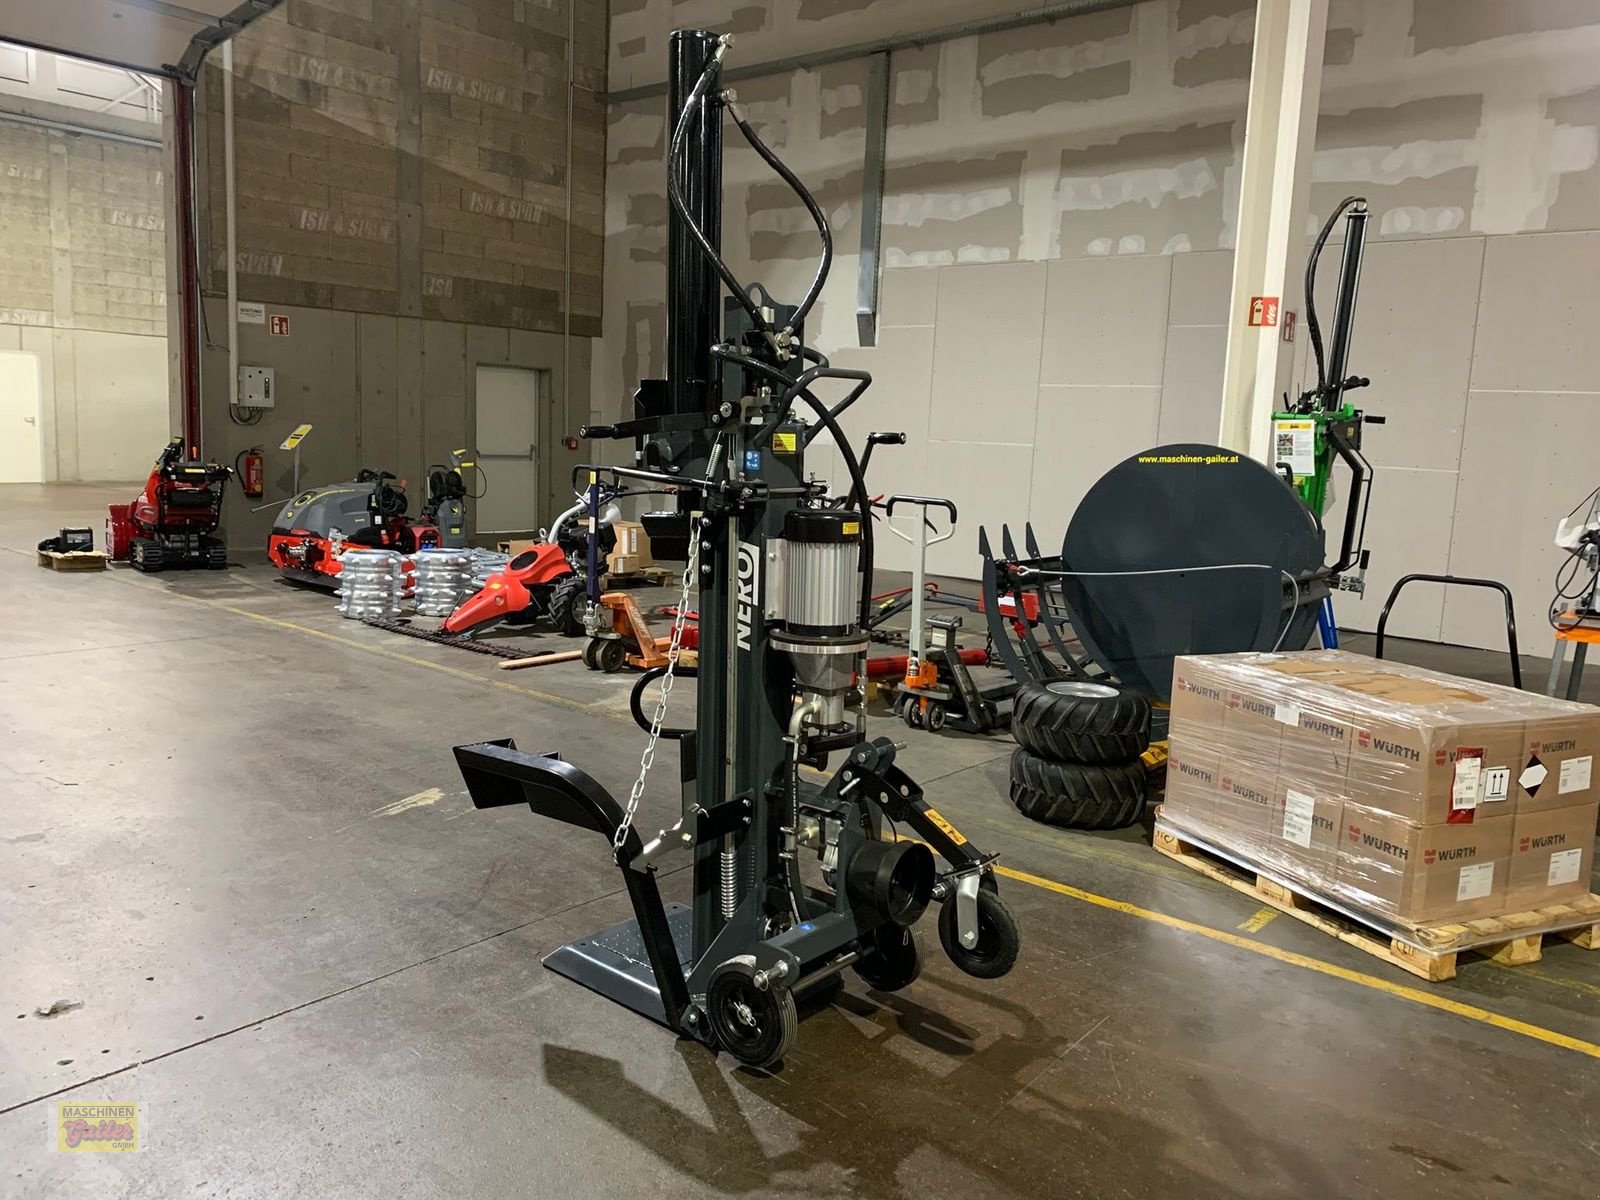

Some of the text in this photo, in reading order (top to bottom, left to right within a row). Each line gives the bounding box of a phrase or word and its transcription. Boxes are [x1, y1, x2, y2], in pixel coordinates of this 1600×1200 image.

[1138, 454, 1239, 465] www.maschinen-gailer.at
[736, 551, 753, 652] NERO
[1374, 738, 1420, 762] WÜRTH
[1542, 740, 1576, 754] WÜRTH
[1179, 762, 1212, 783] WÜRTH
[1312, 815, 1334, 831] RTH
[1364, 833, 1409, 861] WÜRTH
[1531, 834, 1566, 848] WÜRTH
[1438, 846, 1476, 861] WÜRTH
